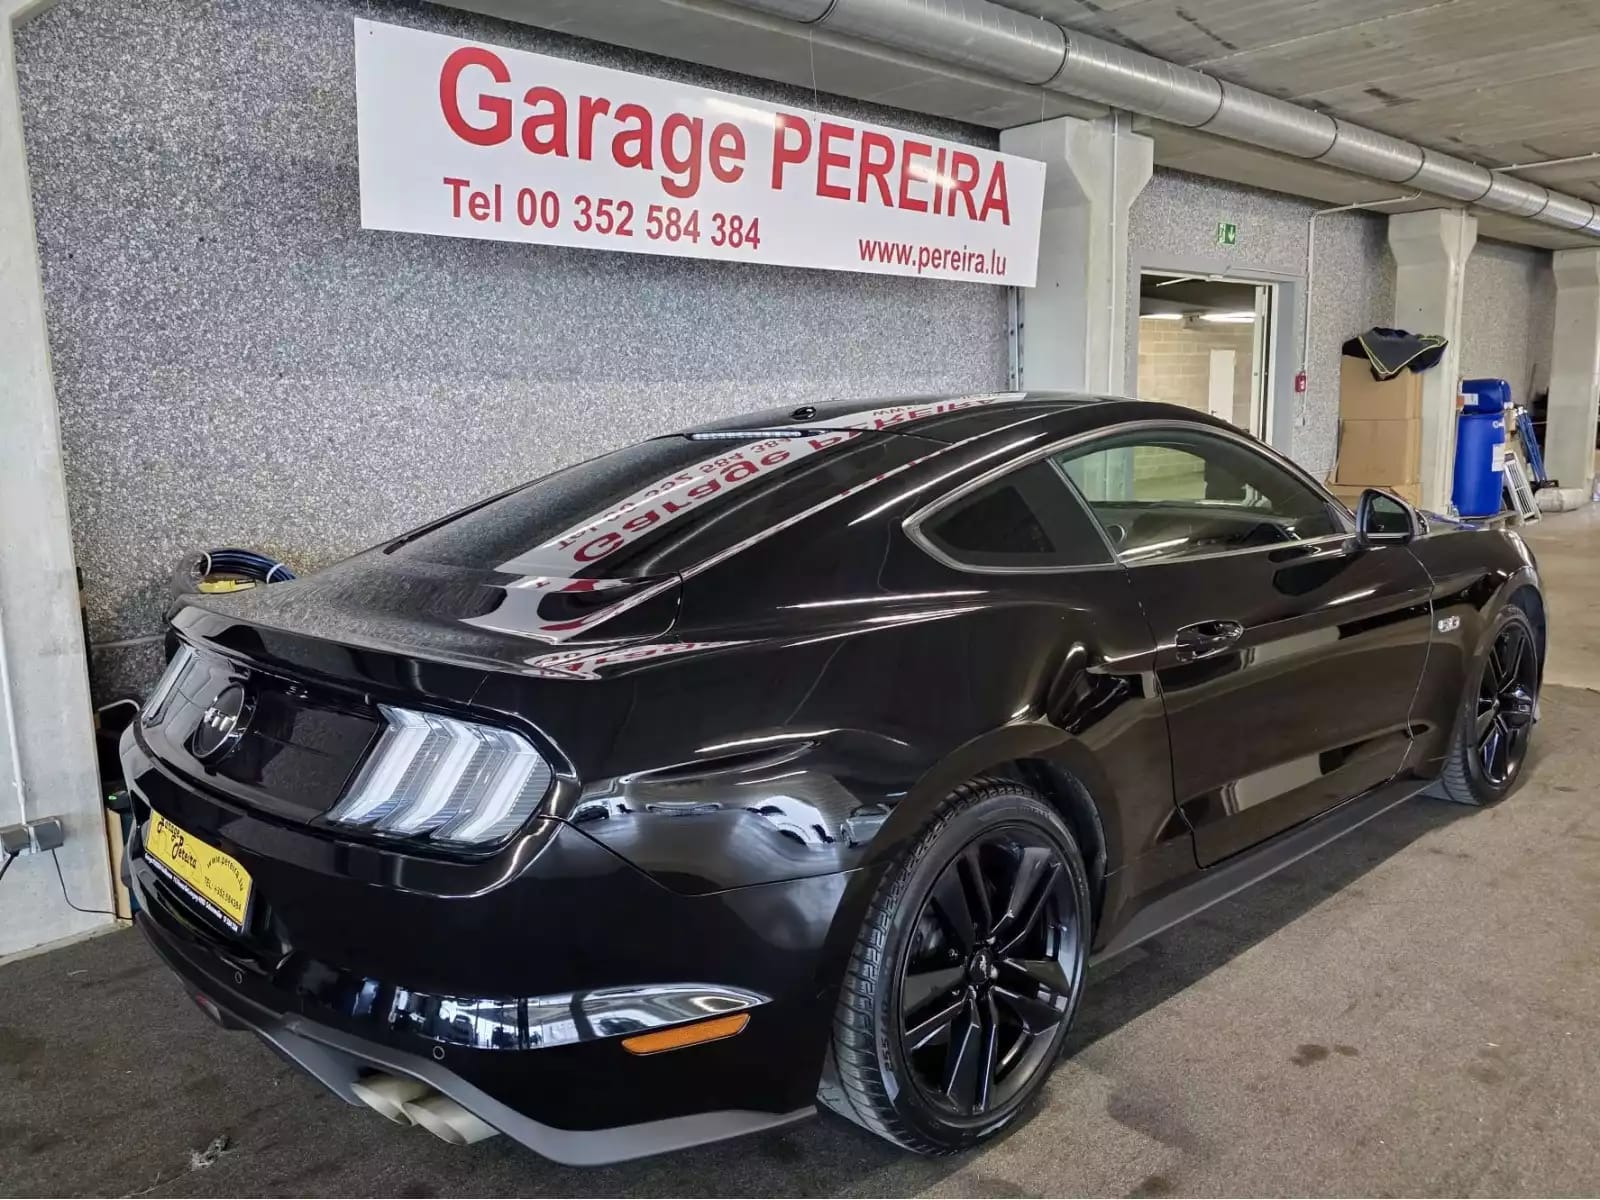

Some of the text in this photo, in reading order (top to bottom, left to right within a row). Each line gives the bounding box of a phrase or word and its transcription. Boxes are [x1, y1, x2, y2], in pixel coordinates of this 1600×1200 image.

[439, 46, 1011, 226] Garage PEREIRA
[443, 177, 761, 250] Tel 00 352 584 384
[858, 238, 1007, 276] www.pereira.lu
